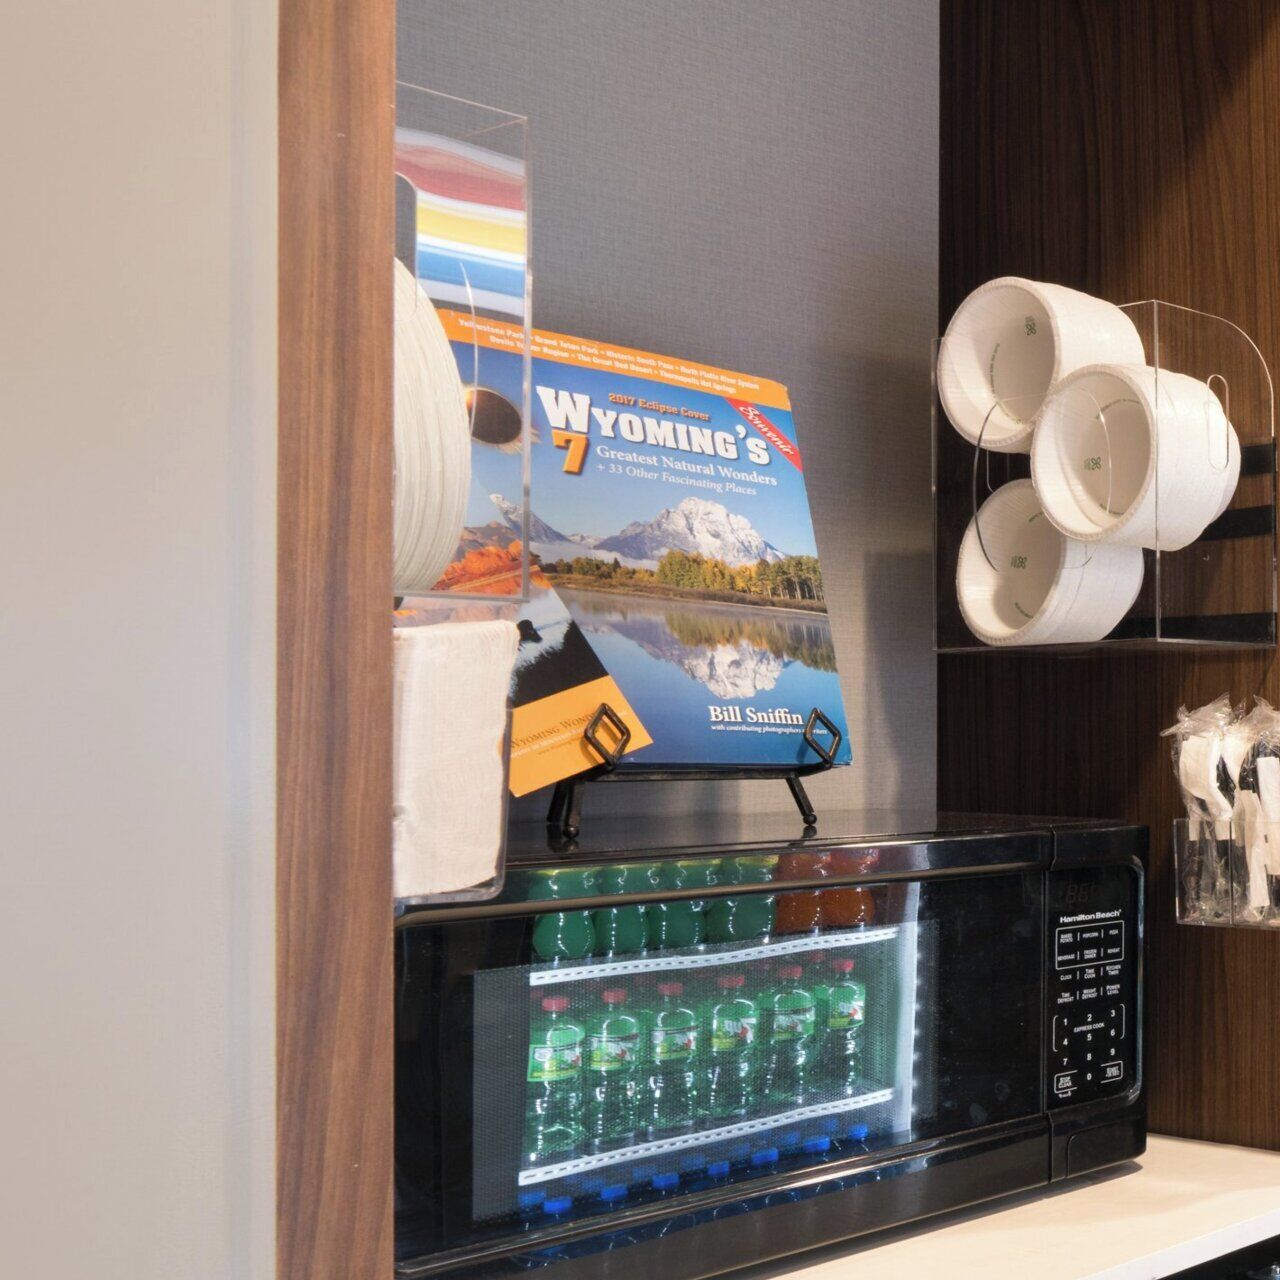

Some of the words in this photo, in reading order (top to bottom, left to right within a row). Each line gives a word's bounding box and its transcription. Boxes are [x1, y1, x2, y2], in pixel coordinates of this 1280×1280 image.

[515, 340, 541, 352] Toer
[581, 345, 600, 355] Park
[608, 392, 635, 406] 2017
[638, 398, 679, 415] Eclipse
[680, 407, 710, 421] Cover
[739, 406, 795, 455] Souvenir
[551, 429, 589, 475] 7
[596, 445, 659, 467] Greatest
[661, 455, 716, 476] Natural
[716, 464, 777, 487] Wonders
[596, 463, 604, 473] +
[608, 463, 623, 475] 33
[625, 466, 659, 482] Other
[661, 472, 723, 493] Fascinating
[725, 482, 758, 496] Places
[707, 705, 743, 722] Bill
[745, 706, 805, 725] Sniffin
[560, 712, 597, 729] WOND
[1060, 913, 1096, 924] Hamilton
[1087, 1013, 1093, 1022] 2
[1110, 1009, 1116, 1017] 3
[1063, 1018, 1068, 1026] 1
[1073, 1024, 1092, 1033] EXPRESS
[1110, 1028, 1116, 1036] 6
[1087, 1033, 1092, 1041] 5
[1062, 1038, 1068, 1046] 4
[1110, 1048, 1116, 1056] 9
[1086, 1053, 1092, 1061] 8
[1063, 1058, 1068, 1066] 7
[1086, 1072, 1092, 1081] 0
